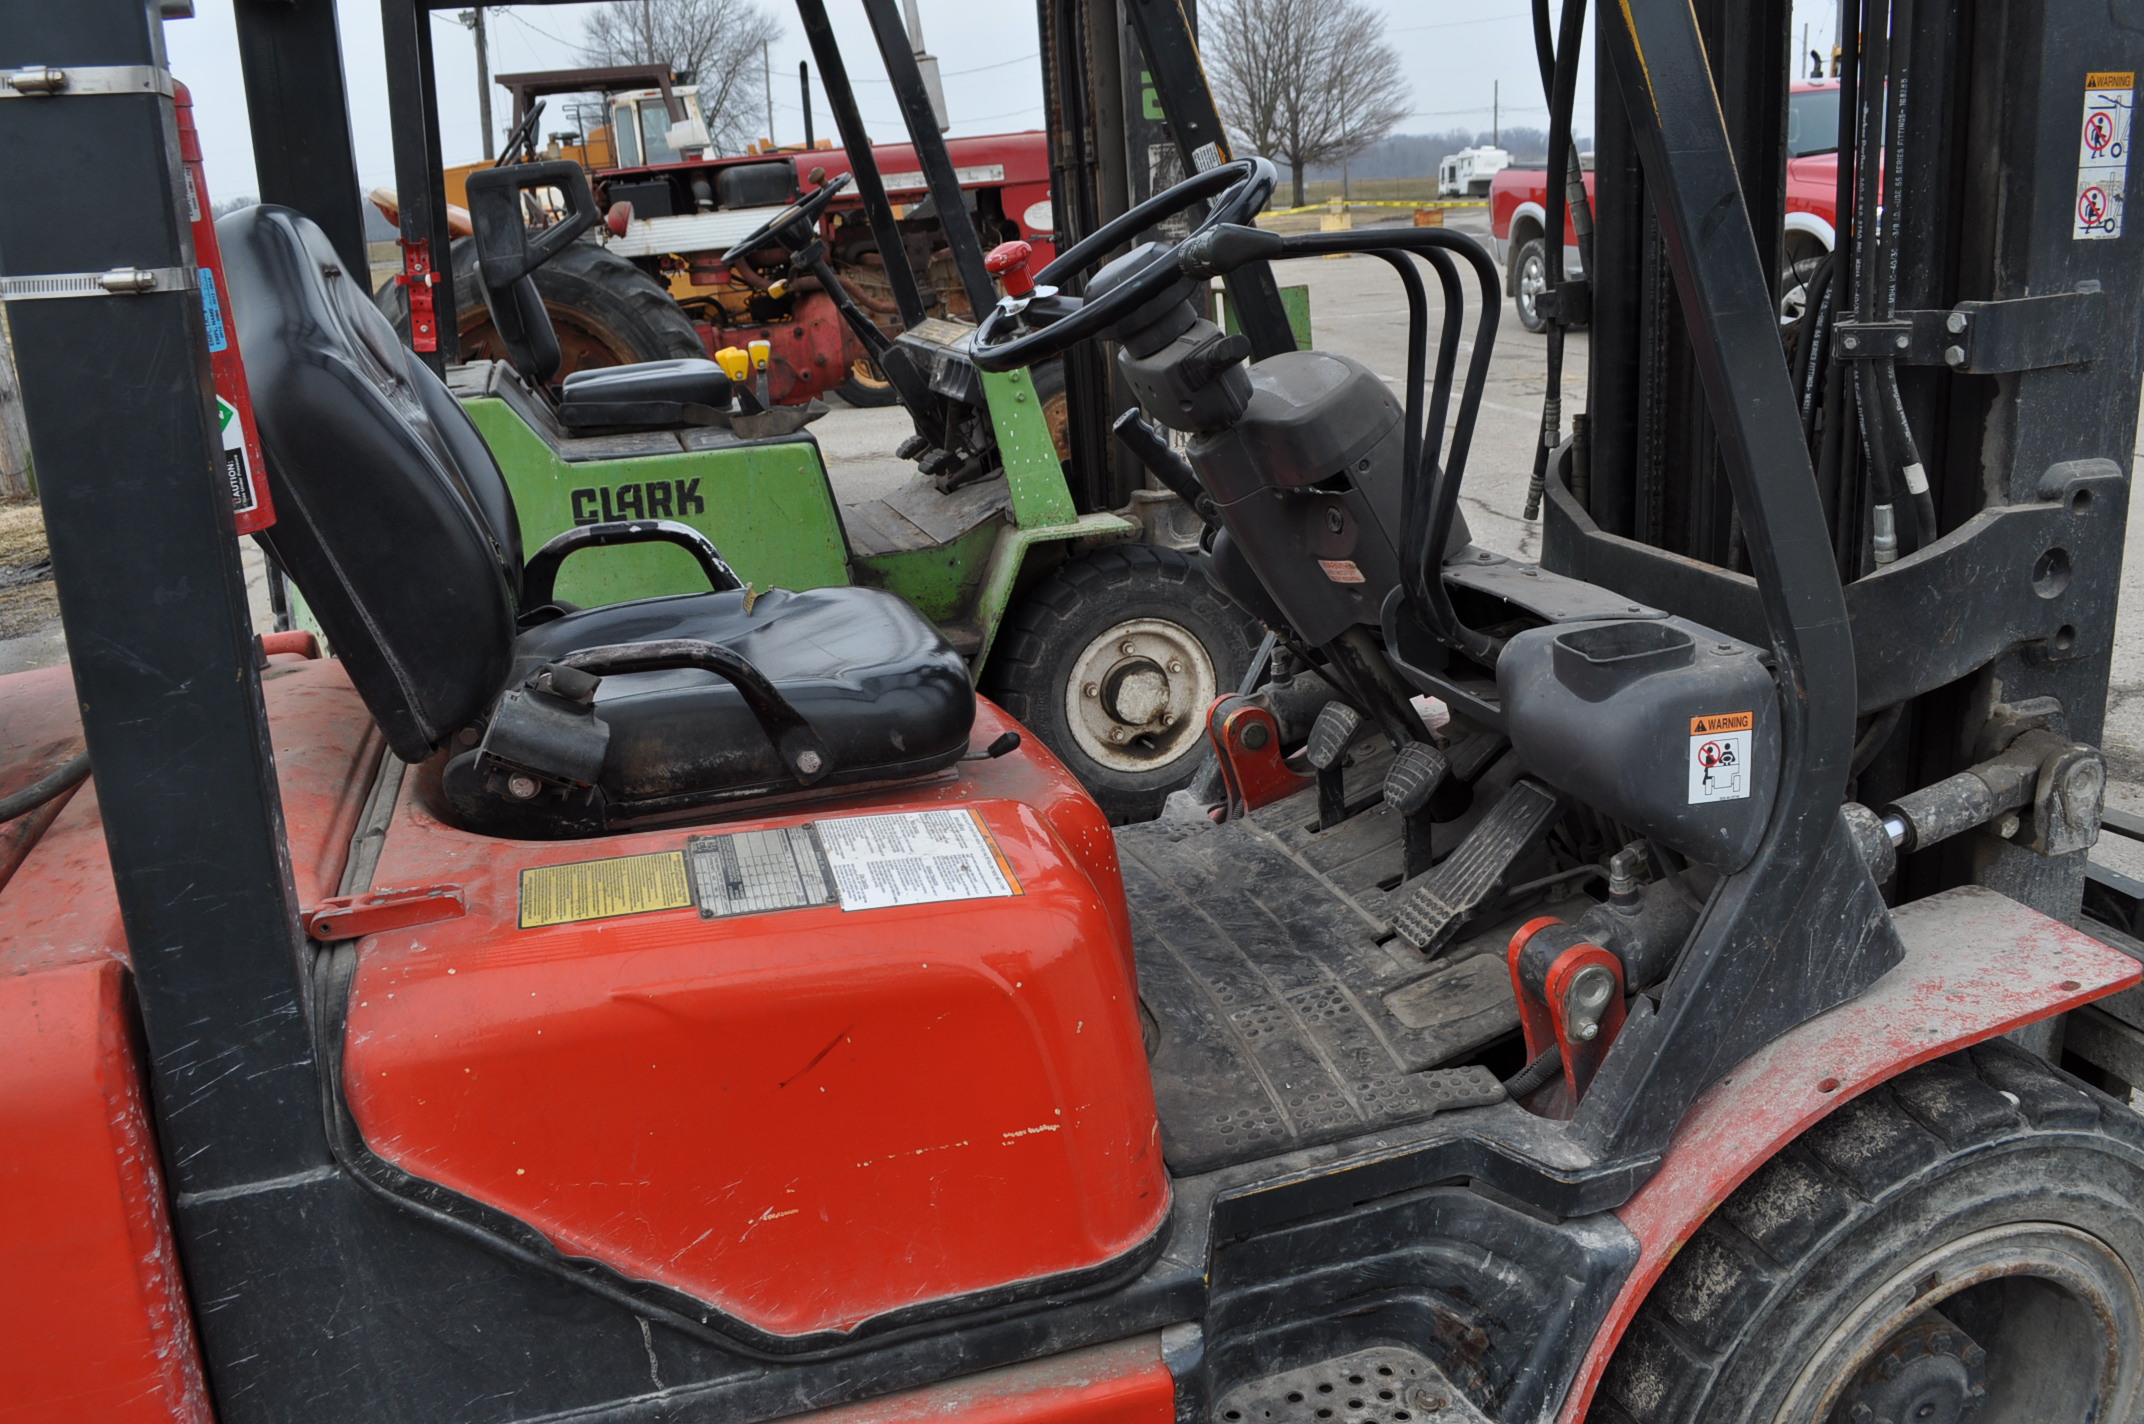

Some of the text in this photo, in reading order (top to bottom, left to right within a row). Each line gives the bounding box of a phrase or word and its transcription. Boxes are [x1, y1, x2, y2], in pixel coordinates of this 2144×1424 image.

[2096, 75, 2131, 87] WARNING
[1896, 148, 1904, 174] SERIES
[213, 326, 221, 345] EMPL.
[1810, 340, 1819, 361] SERIES
[233, 454, 242, 477] Pressure
[571, 477, 705, 526] CLARK
[1708, 715, 1749, 731] WARNING
